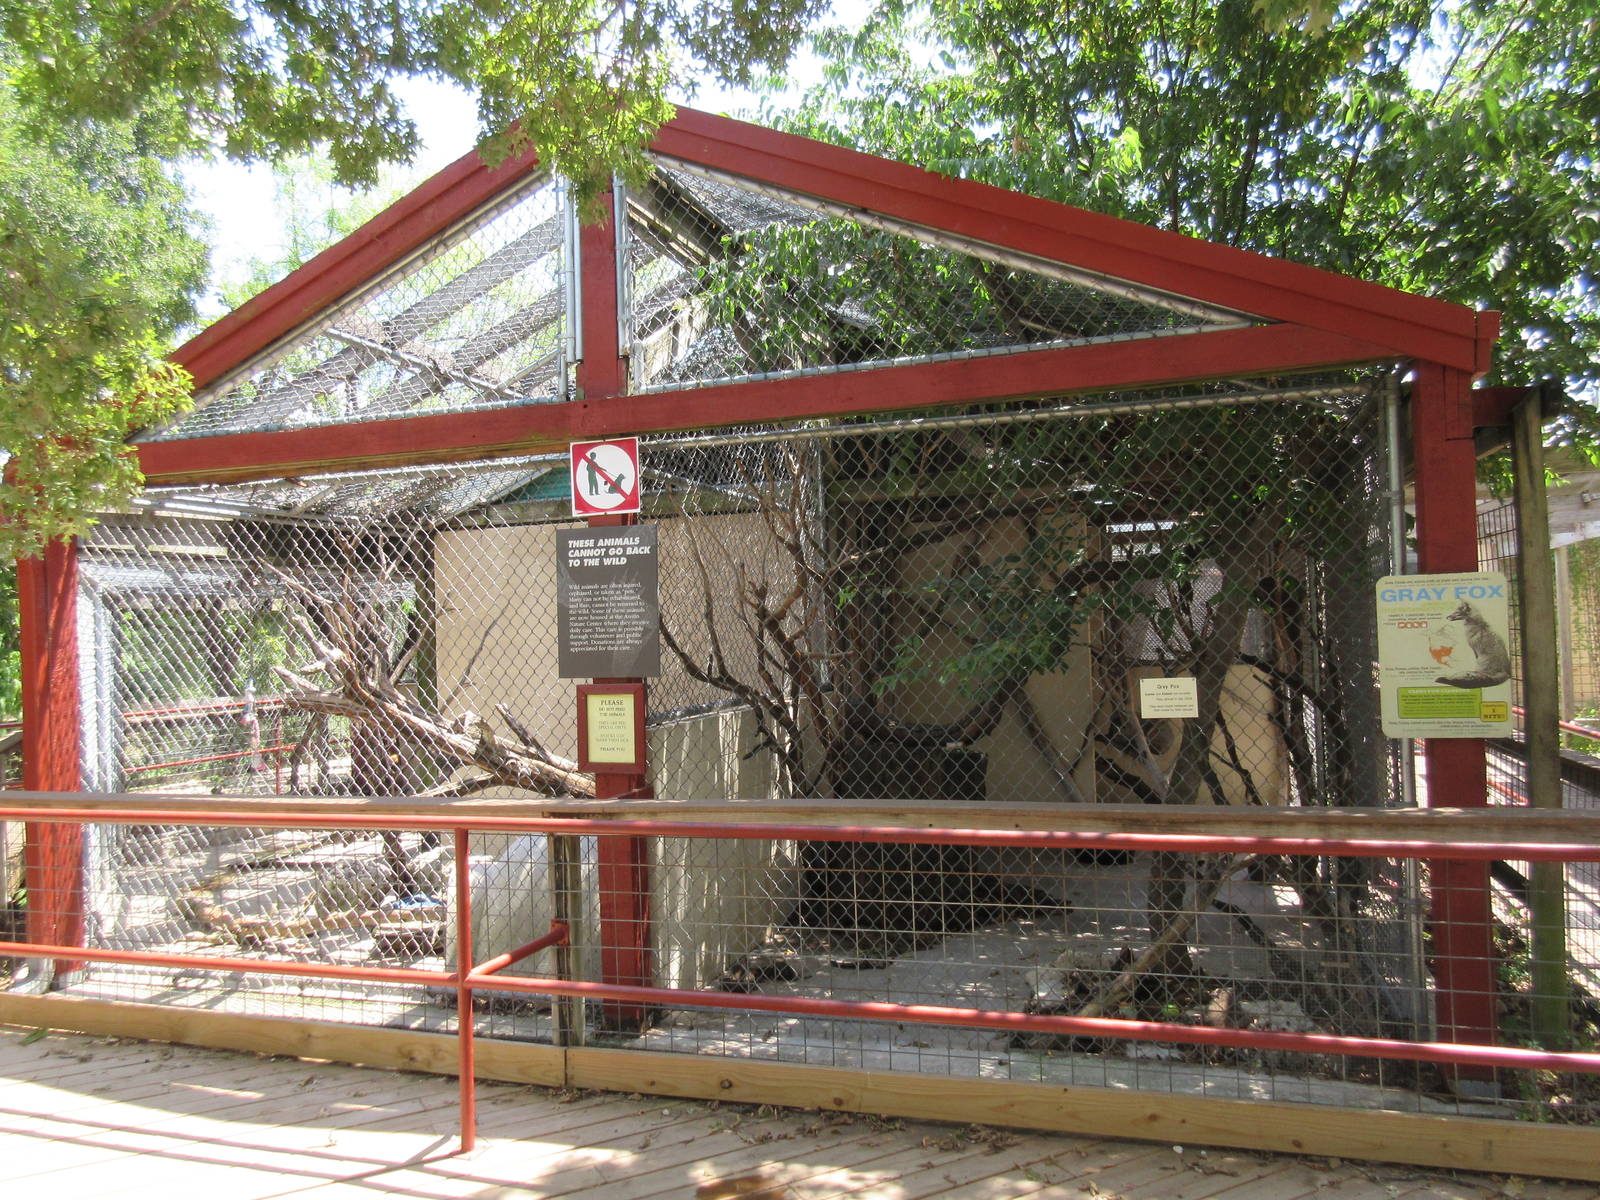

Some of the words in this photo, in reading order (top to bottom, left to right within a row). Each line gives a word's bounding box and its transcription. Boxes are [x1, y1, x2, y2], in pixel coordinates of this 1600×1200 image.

[568, 540, 594, 548] THESE
[597, 537, 640, 546] ANIMALS
[568, 548, 606, 557] CANNOT
[608, 548, 623, 556] GO
[626, 546, 651, 555] BACK
[568, 559, 580, 567] TO
[603, 557, 627, 566] WILD
[1381, 588, 1446, 602] GRAY
[1454, 585, 1504, 600] FOX
